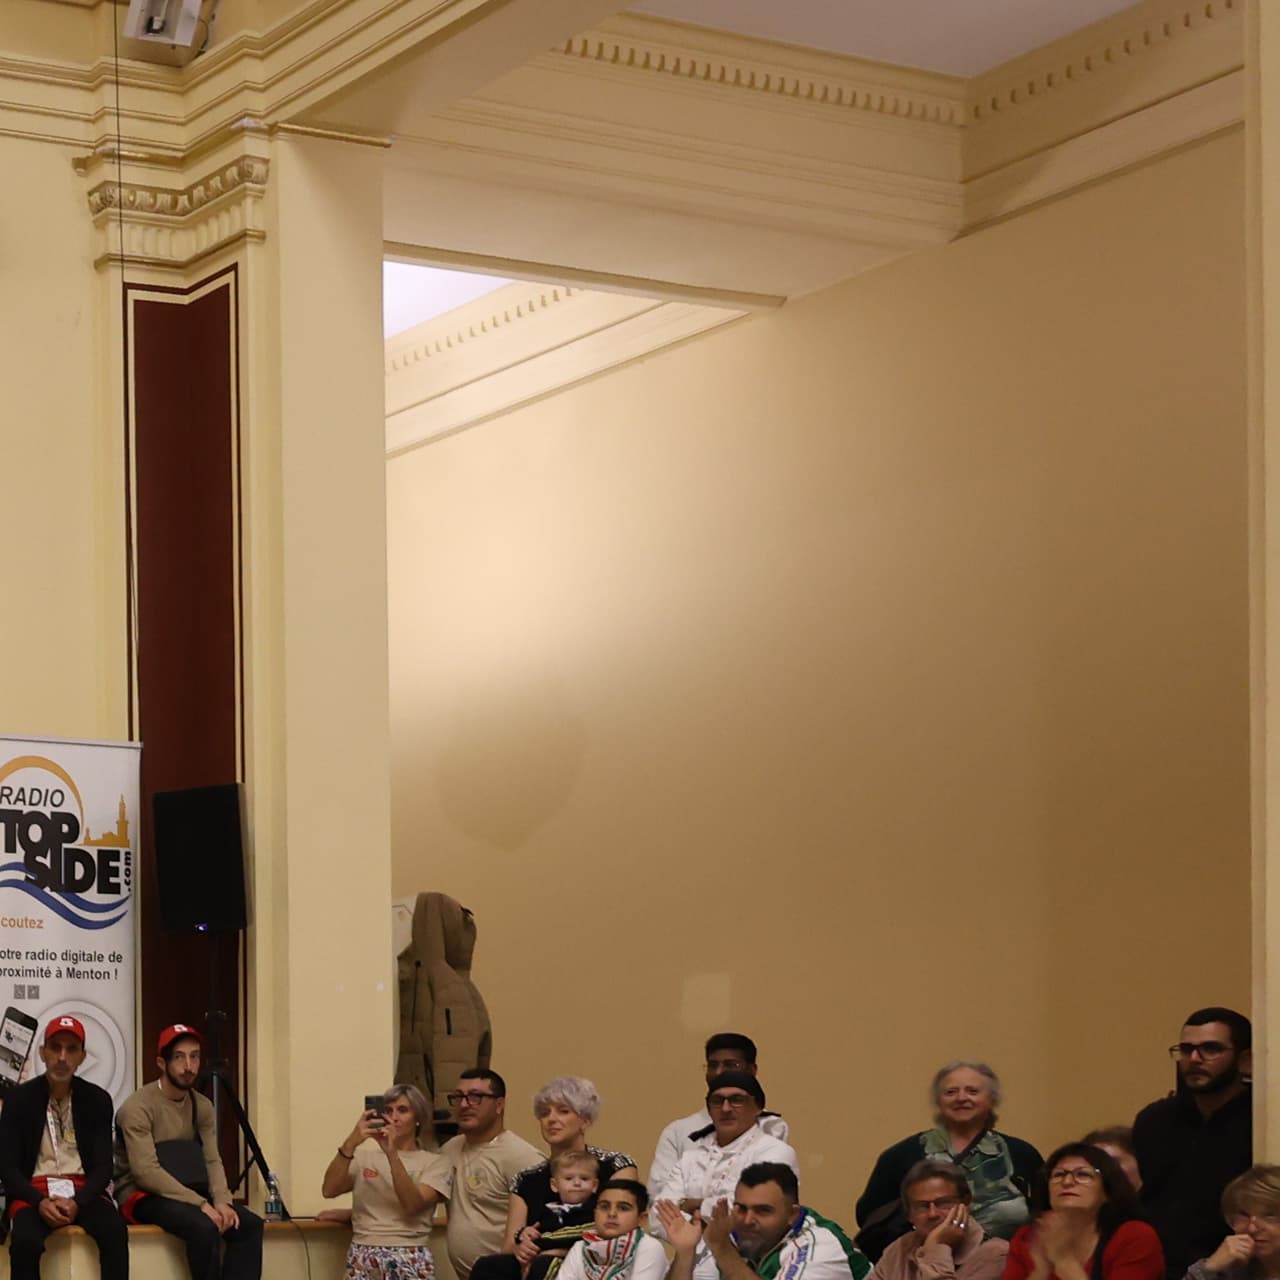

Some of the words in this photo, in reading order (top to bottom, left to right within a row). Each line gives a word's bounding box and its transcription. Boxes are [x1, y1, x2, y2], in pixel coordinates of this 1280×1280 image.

[0, 786, 65, 808] RADIO
[24, 847, 122, 896] SIDE
[25, 949, 58, 962] radio
[60, 949, 106, 966] digitale
[108, 951, 123, 964] de
[55, 966, 64, 979] à
[66, 967, 111, 981] Menton
[114, 967, 118, 980] !
